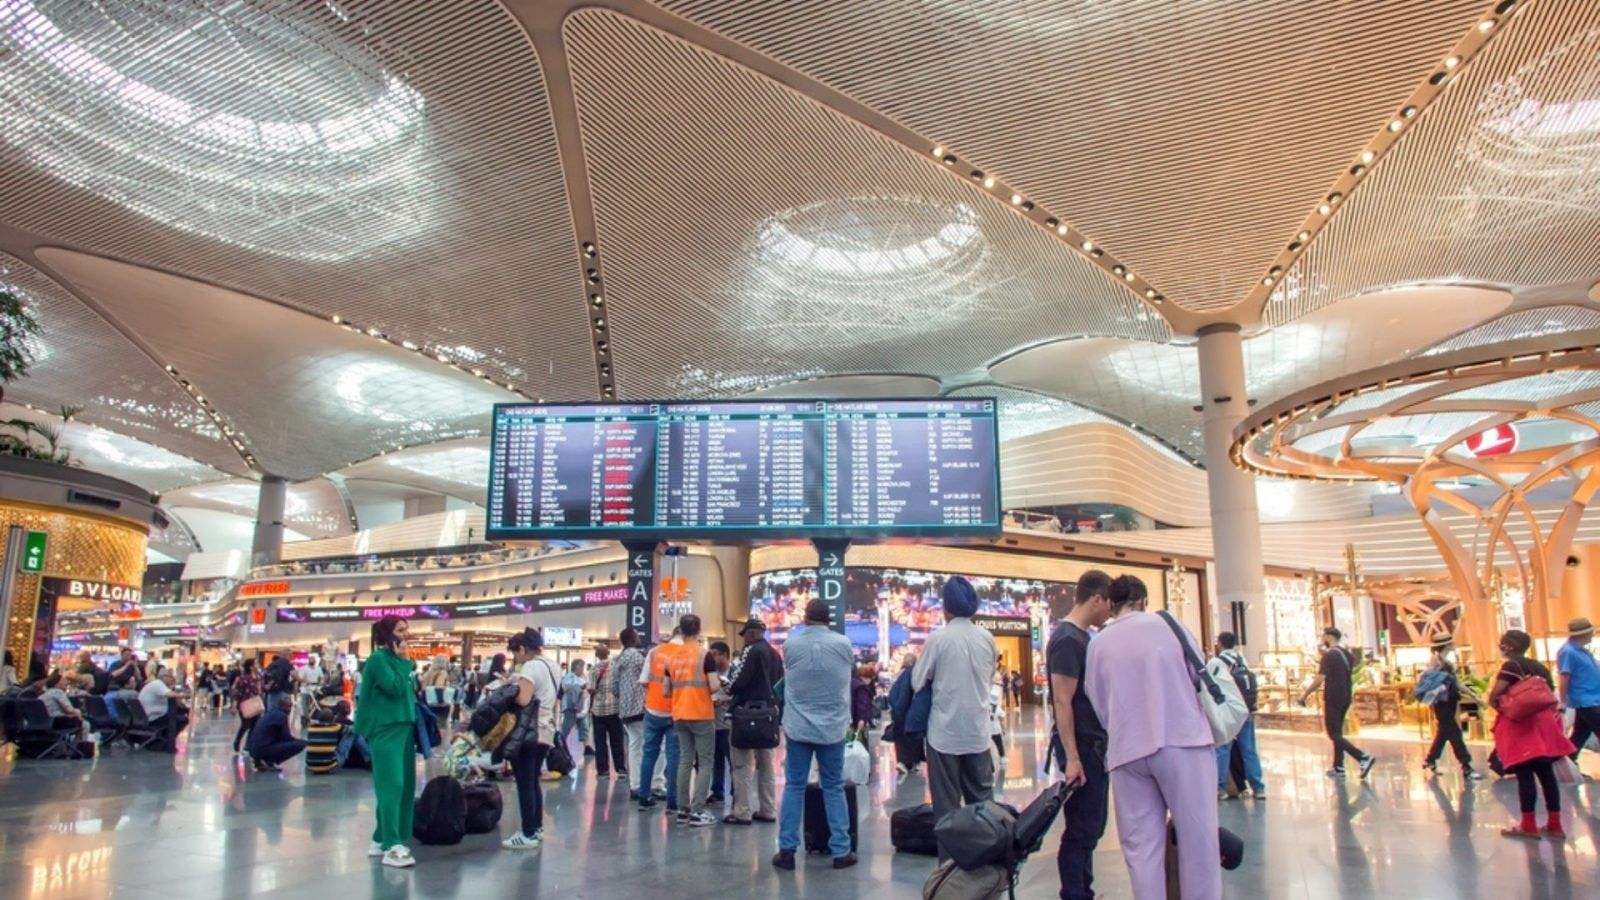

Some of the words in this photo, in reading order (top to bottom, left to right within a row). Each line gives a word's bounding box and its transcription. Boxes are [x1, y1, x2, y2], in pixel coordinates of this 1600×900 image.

[629, 569, 652, 577] GATES
[819, 567, 844, 576] GATES
[631, 581, 648, 601] A
[825, 579, 841, 600] D
[585, 592, 603, 602] FREE
[363, 610, 383, 620] FREE
[632, 606, 645, 626] B
[998, 621, 1028, 631] VUITTON
